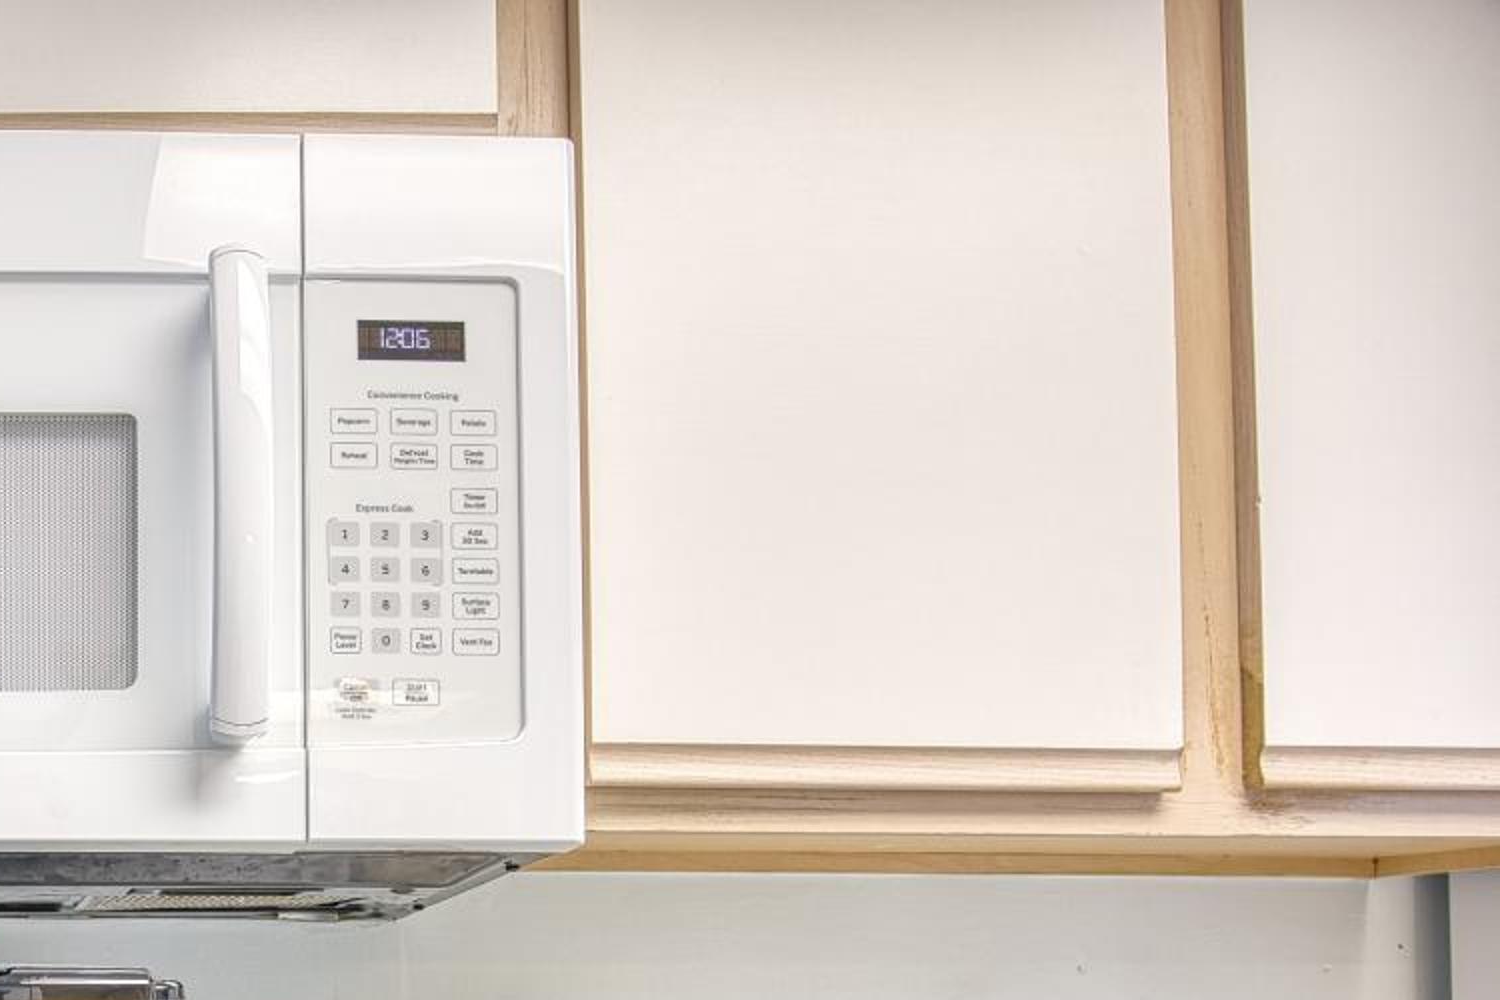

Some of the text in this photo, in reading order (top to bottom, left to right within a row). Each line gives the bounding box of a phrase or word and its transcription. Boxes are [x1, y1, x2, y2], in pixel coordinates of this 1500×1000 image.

[379, 327, 431, 349] 12:06
[342, 529, 348, 540] 1
[381, 530, 389, 540] 2
[421, 530, 429, 541] 3
[341, 564, 350, 574] 4
[381, 565, 389, 575] 5
[421, 565, 430, 576] 6
[342, 599, 349, 609] 7
[381, 600, 390, 611] 8
[422, 600, 430, 610] 9
[382, 636, 390, 647] 0
